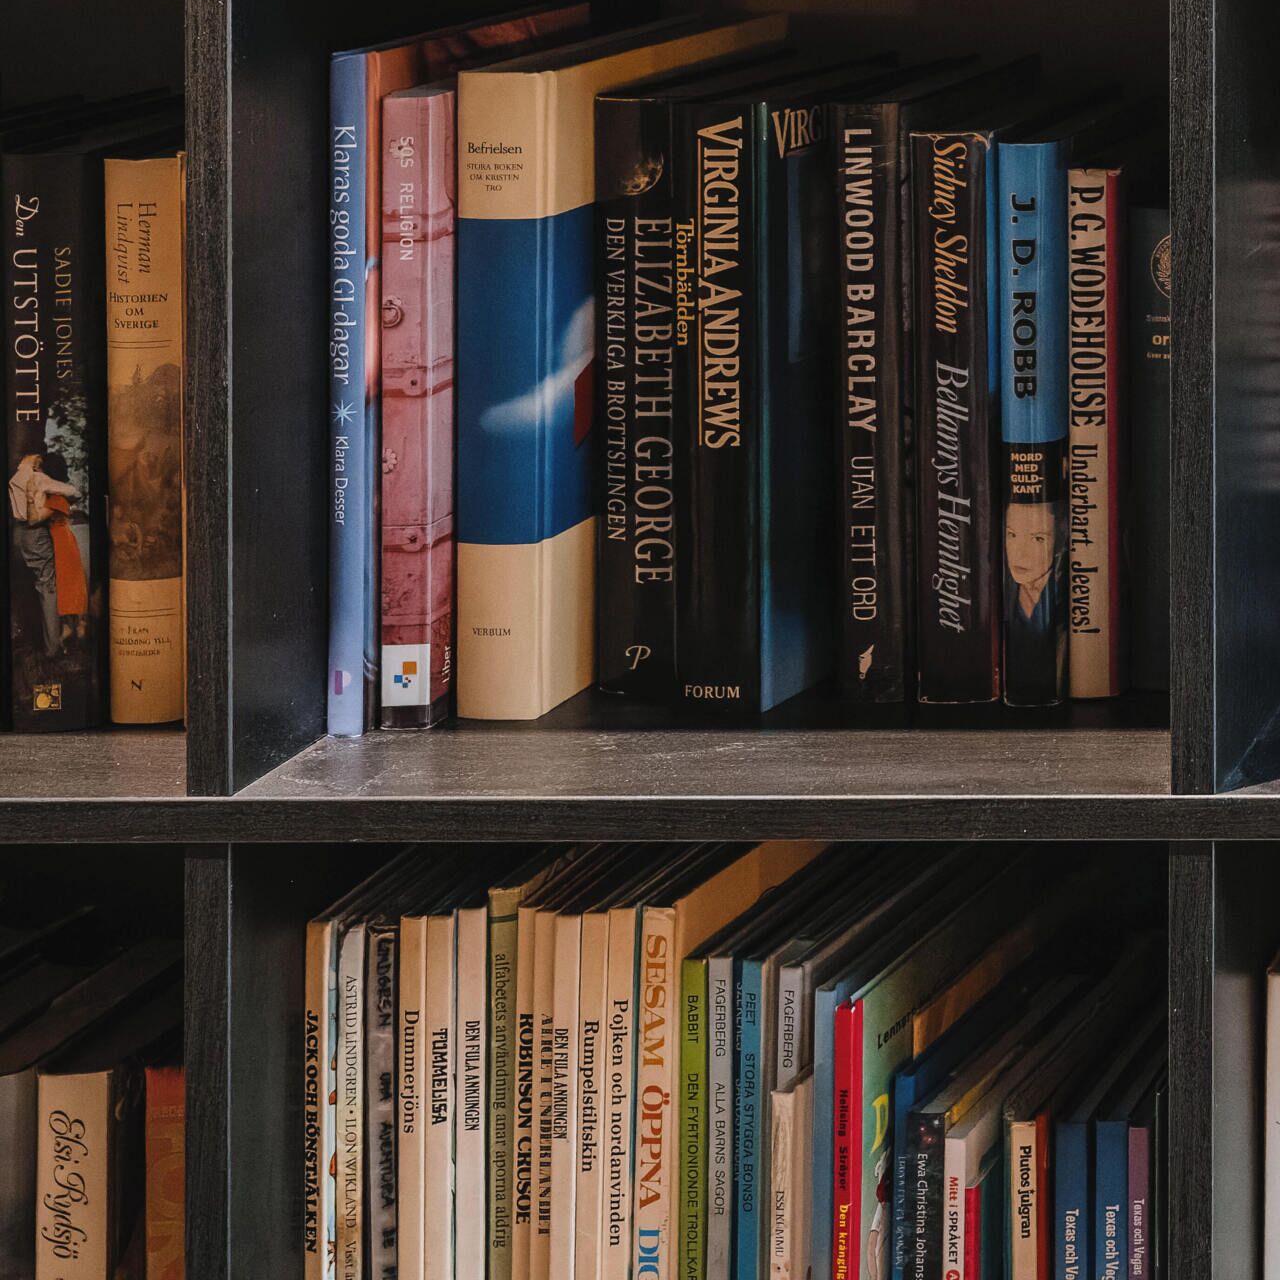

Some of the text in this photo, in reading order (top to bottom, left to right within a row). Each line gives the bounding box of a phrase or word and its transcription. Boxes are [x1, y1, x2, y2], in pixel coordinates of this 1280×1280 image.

[54, 247, 74, 379] SADIE JONES
[329, 125, 357, 384] Klaras goda GI-dagar
[674, 217, 695, 346] Törnbädden
[1010, 192, 1037, 400] J. D. ROBB
[632, 216, 674, 585] ELIZABETH GEORGE
[843, 128, 877, 622] LINWOOD BARCLAY UTAN ETT ORD
[334, 435, 349, 526] Klara Desser
[639, 934, 670, 1209] SESAM ÖPPNA
[687, 995, 699, 1044] BABBIT
[745, 992, 756, 1025] PEET
[783, 990, 794, 1068] FAGERBERG
[402, 1010, 419, 1134] Dummerjöns
[431, 1028, 448, 1125] TUMMELISA
[464, 1020, 480, 1131] DEN FULA ANKUNGEN
[579, 1020, 599, 1173] Rumpelstiltskin
[609, 999, 629, 1246] Pojken och nordanvinden
[41, 1110, 88, 1260] Elsi Rydsjö
[949, 1177, 959, 1201] Mitt
[949, 1211, 962, 1264] SPRÅKET
[1018, 1145, 1034, 1239] Plutos julgran
